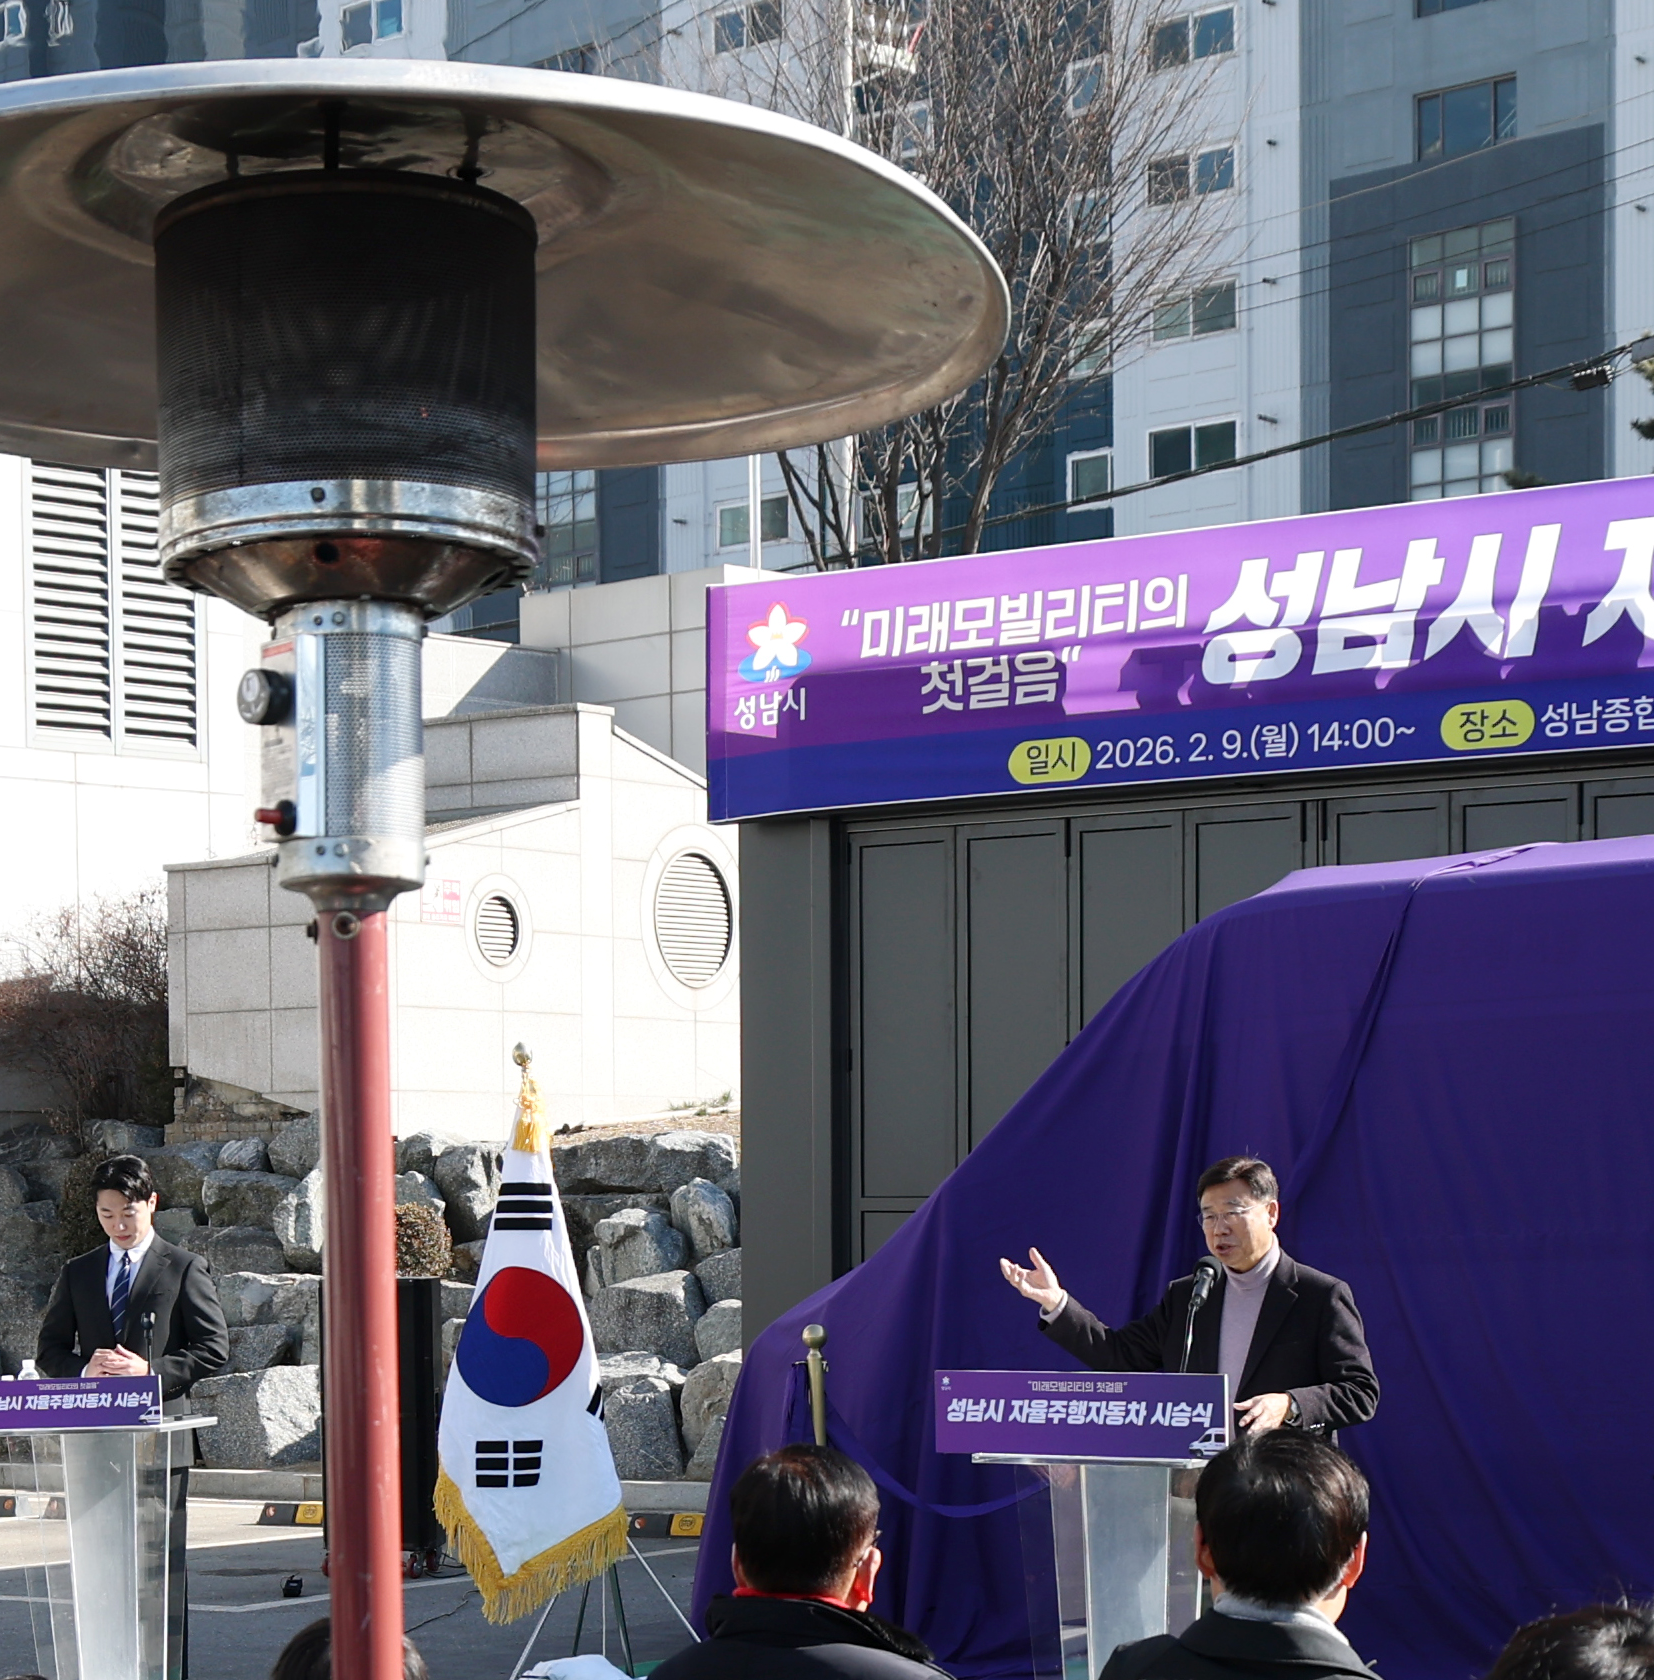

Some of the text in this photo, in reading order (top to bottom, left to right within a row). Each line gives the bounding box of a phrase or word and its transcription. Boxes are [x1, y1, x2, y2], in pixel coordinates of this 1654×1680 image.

[1203, 529, 1551, 684] 성남시
[733, 687, 808, 731] 성남시
[1458, 709, 1521, 743] 장소
[1024, 743, 1080, 776] 일시
[1094, 738, 1183, 772] 2026.
[24, 1392, 113, 1411] 자율주행자동차
[114, 1391, 153, 1408] 시승식
[946, 1397, 1212, 1427] 성남시 자율주행자동차 시승식
